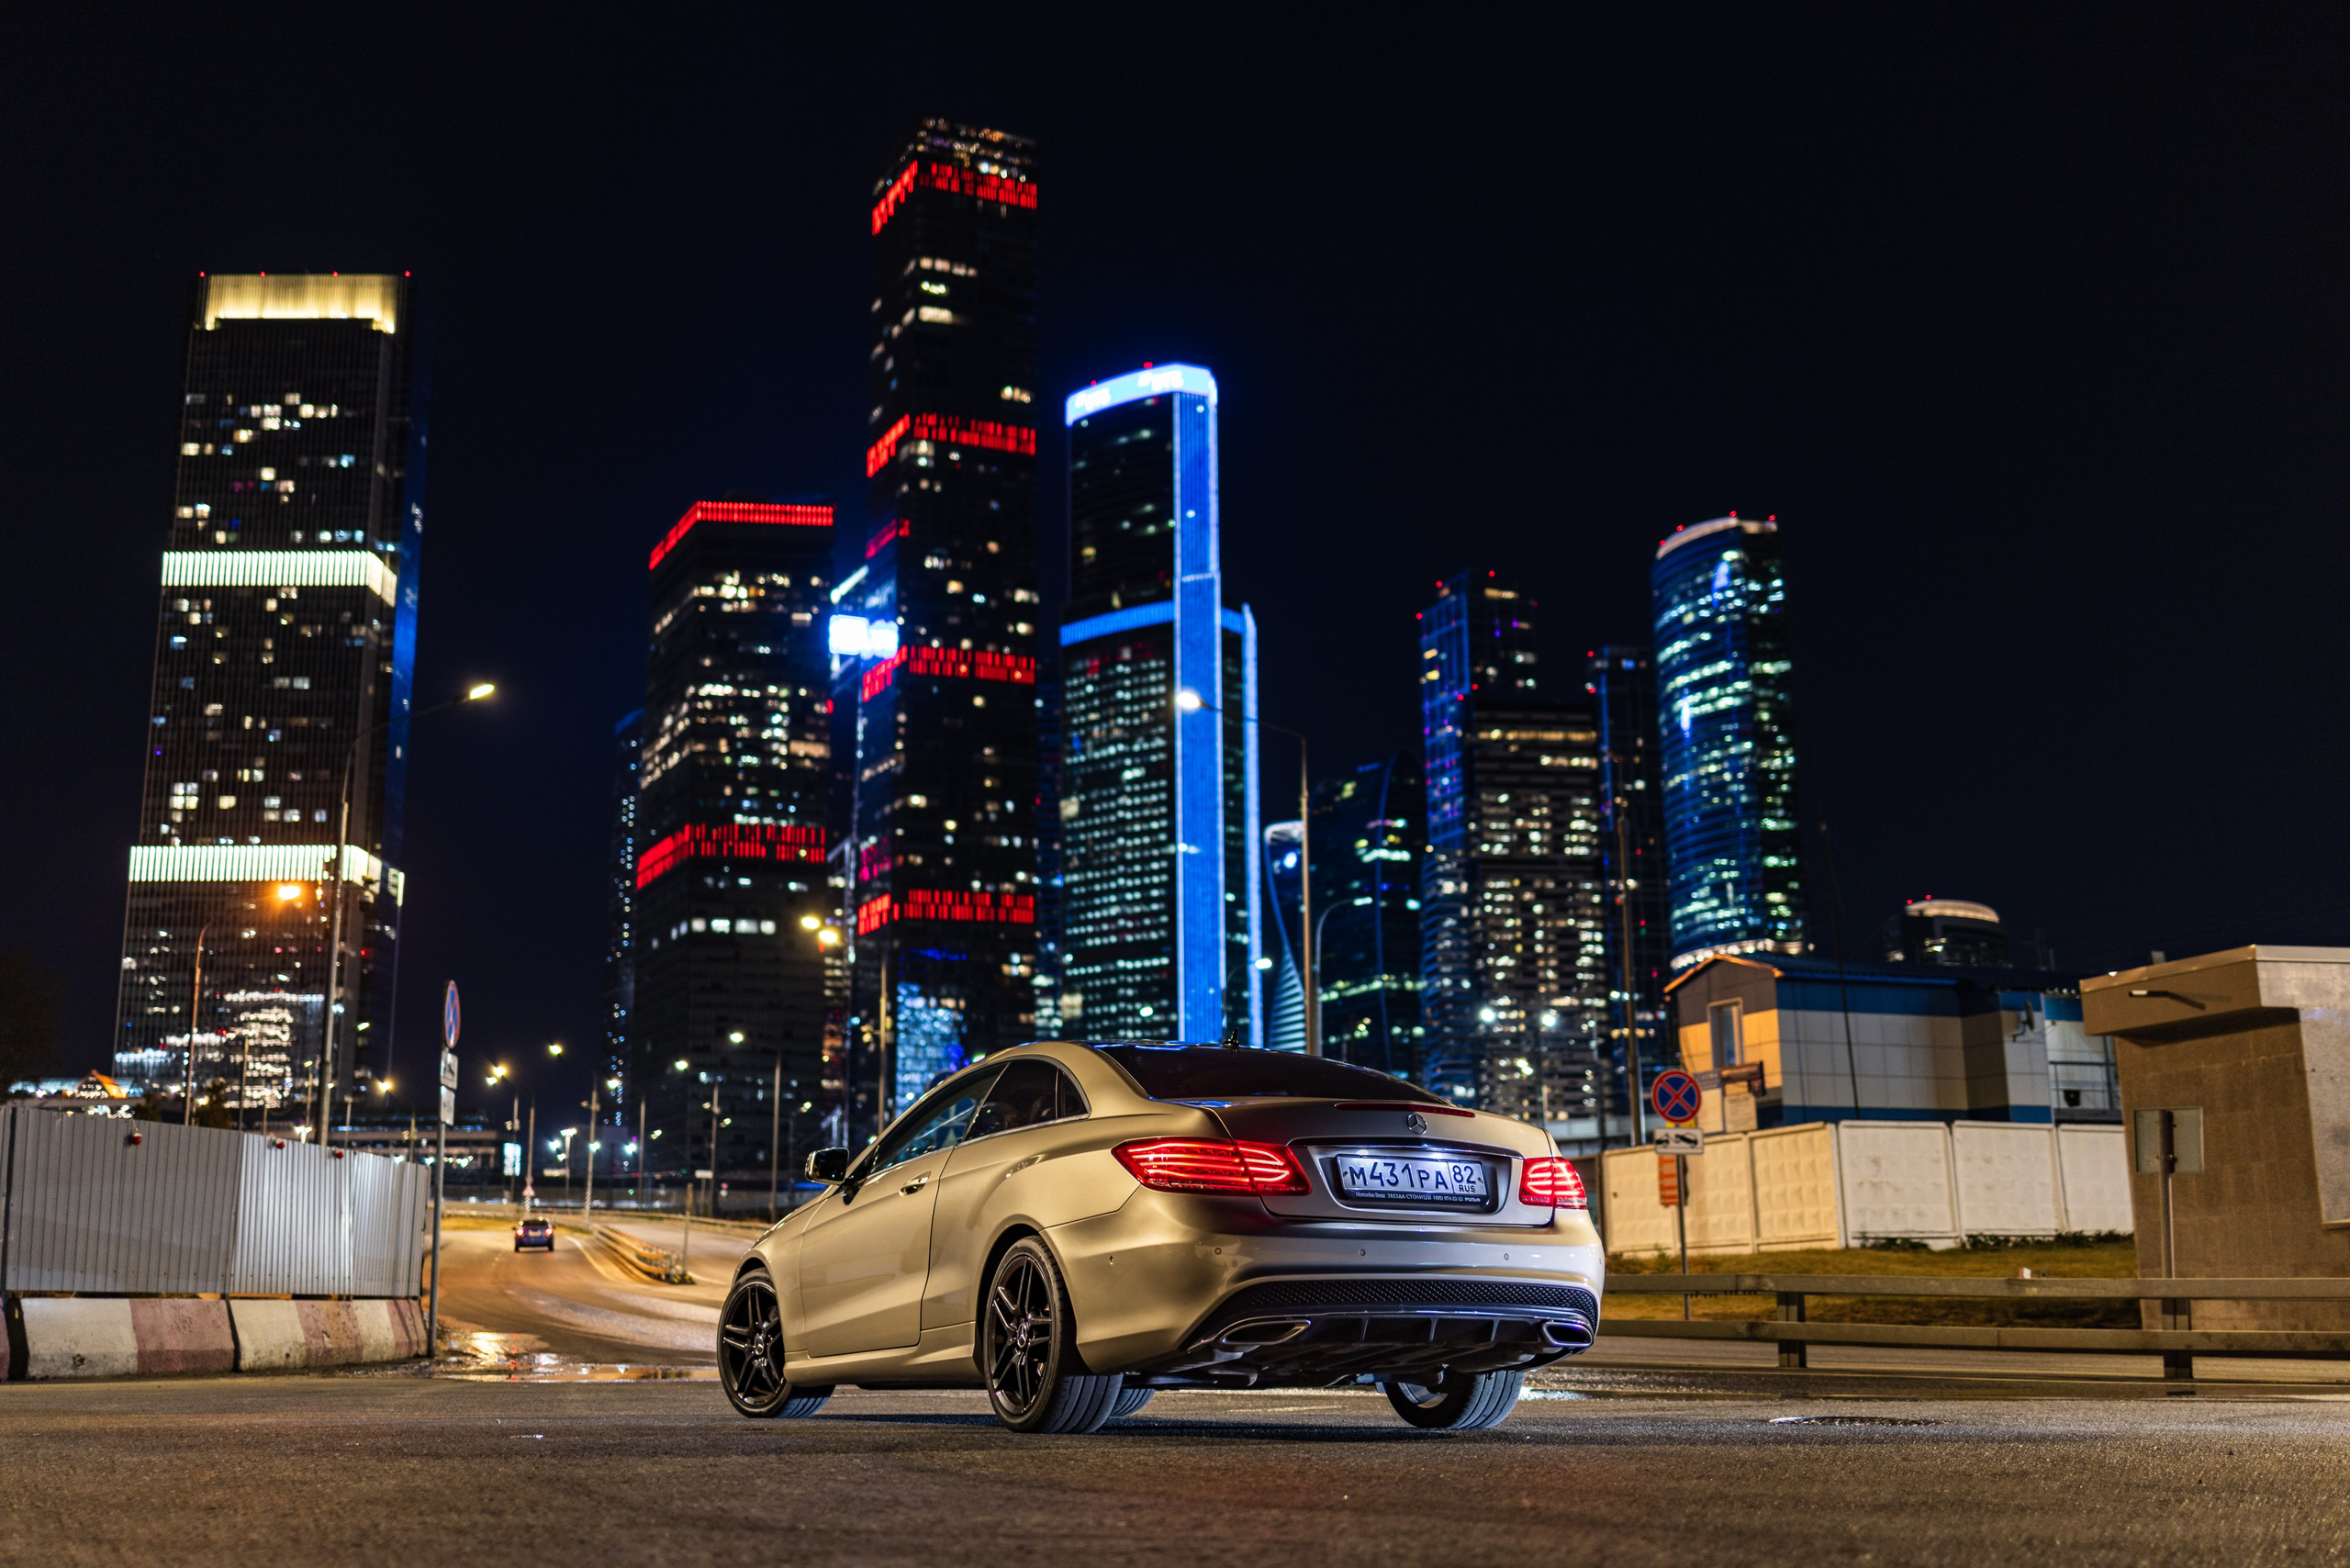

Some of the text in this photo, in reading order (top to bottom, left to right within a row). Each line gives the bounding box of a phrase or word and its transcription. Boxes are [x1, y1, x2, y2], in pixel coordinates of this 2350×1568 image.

[1348, 1161, 1476, 1190] М431РА 82
[1459, 1184, 1476, 1193] RUS
